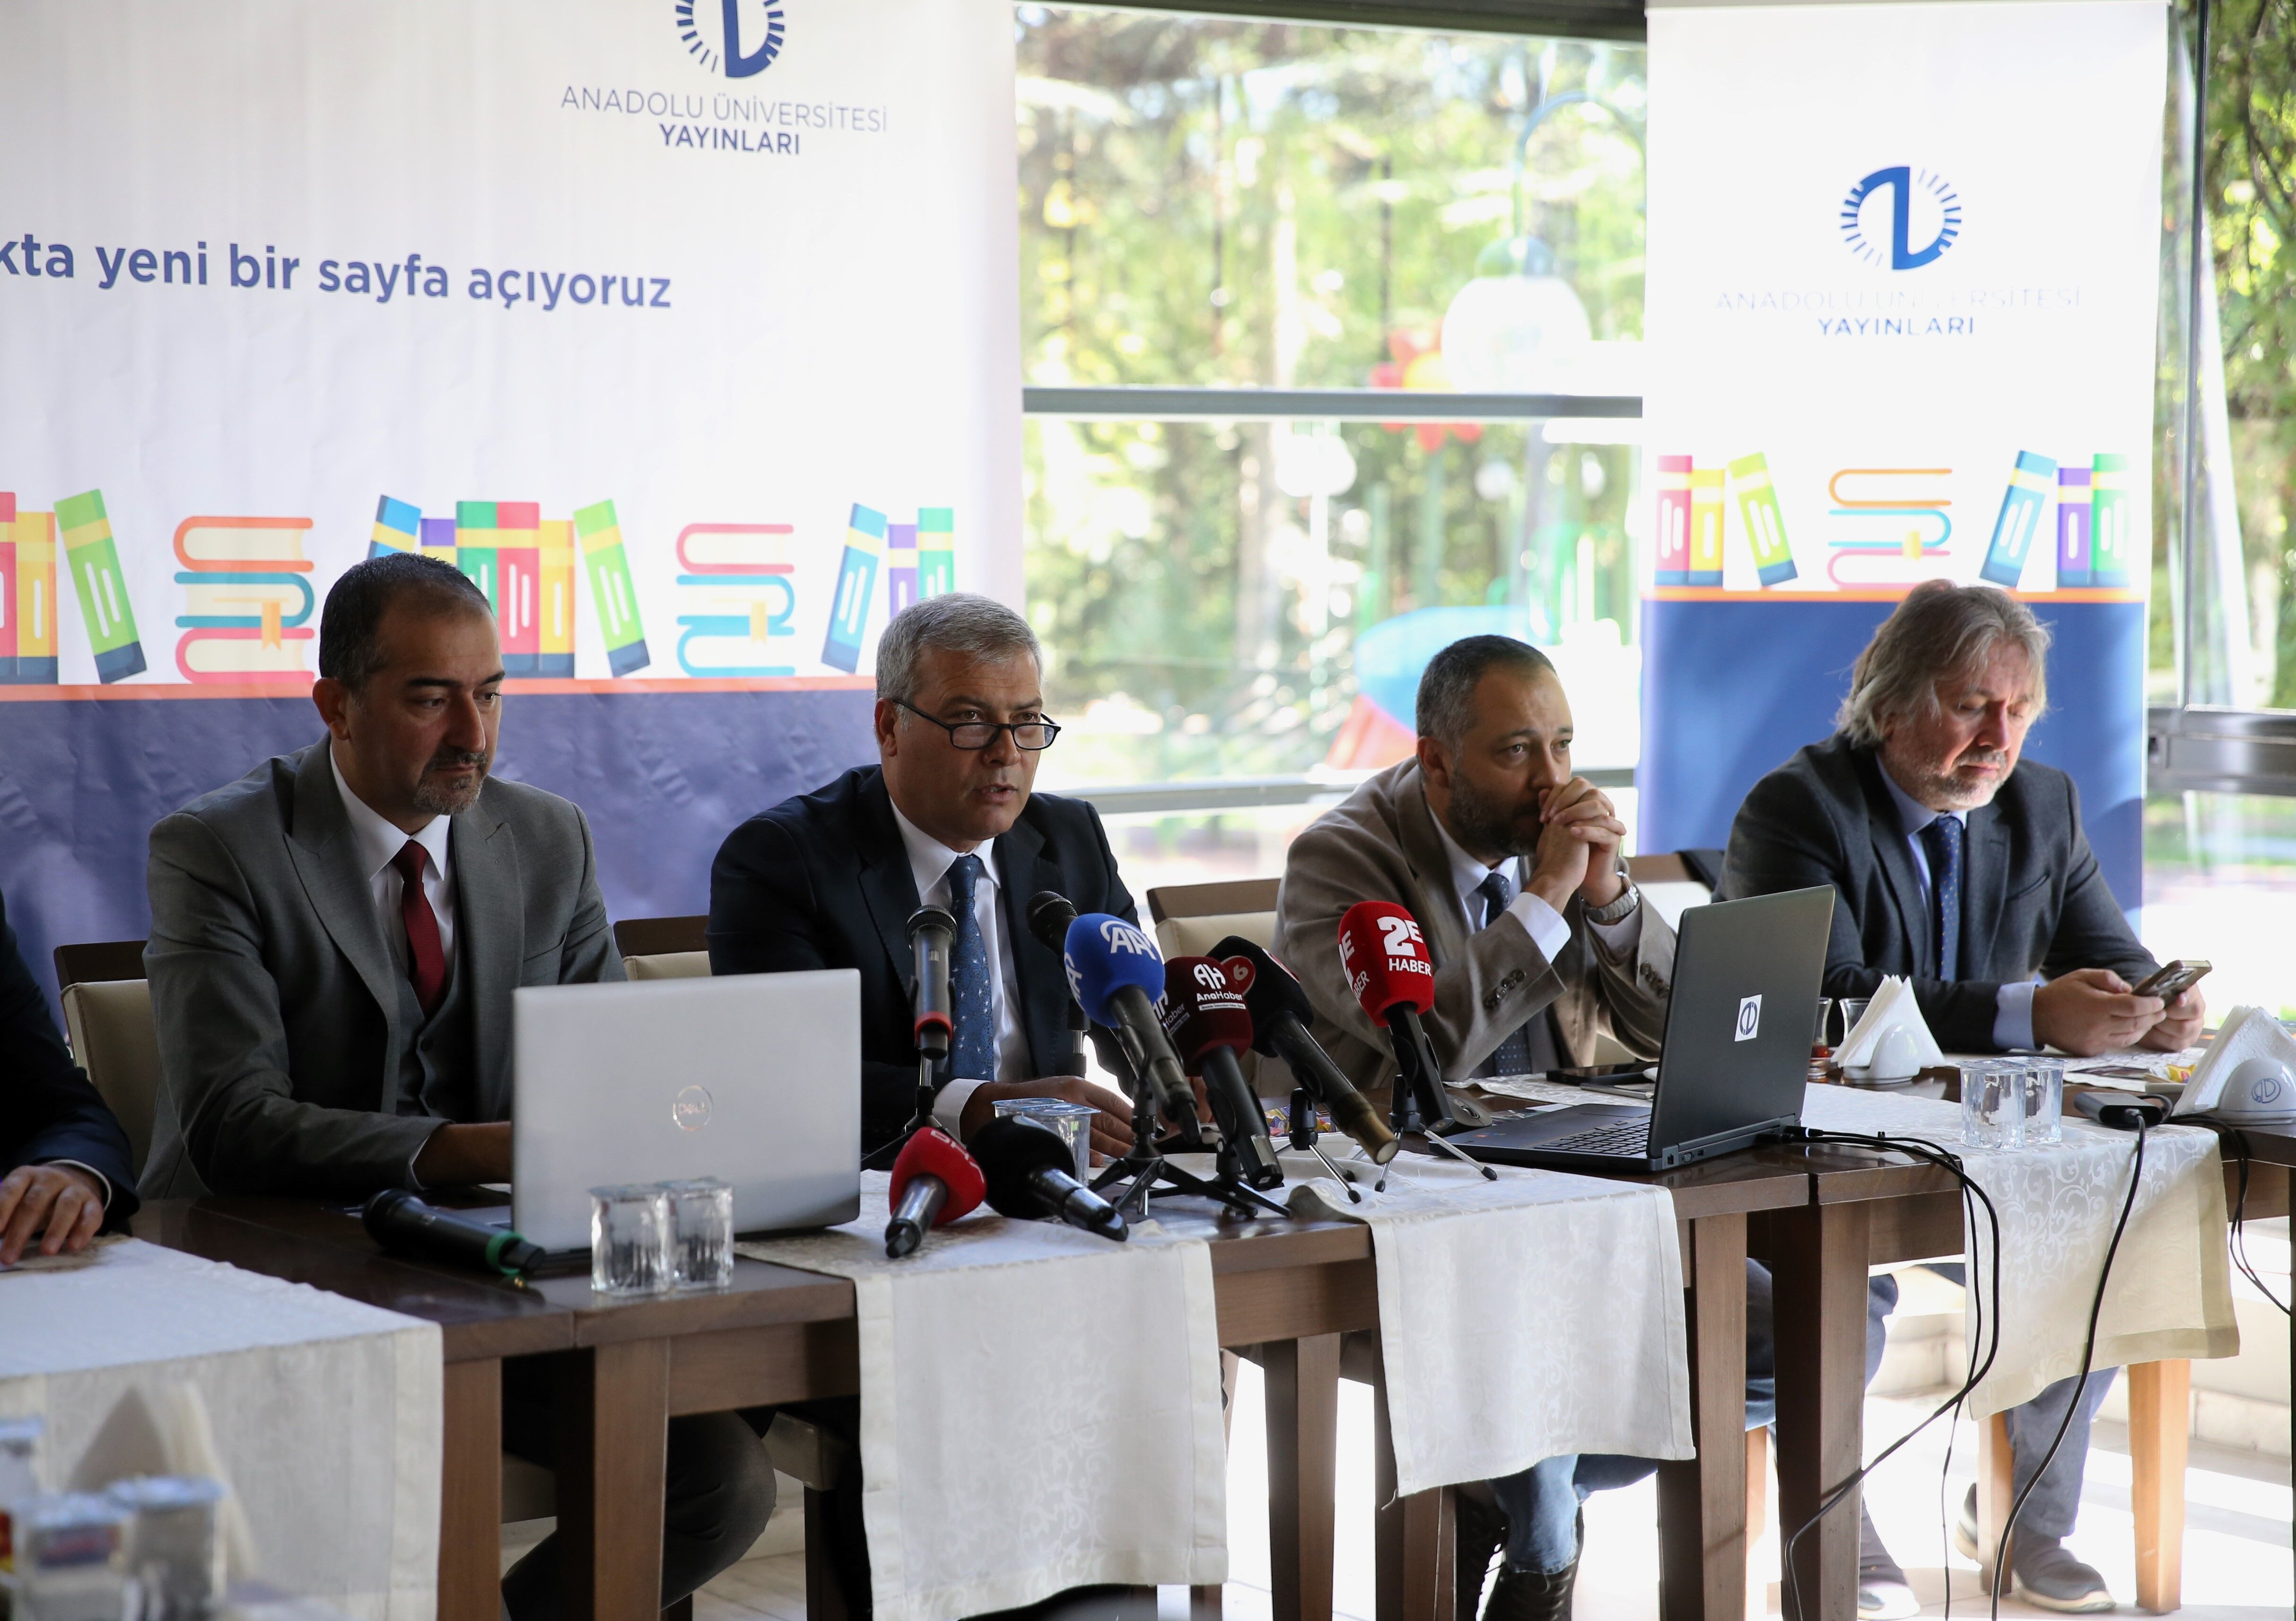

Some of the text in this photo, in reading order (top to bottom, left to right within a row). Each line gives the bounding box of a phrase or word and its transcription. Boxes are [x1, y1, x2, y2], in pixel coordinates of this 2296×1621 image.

[561, 85, 887, 133] ANADOLU ÜNİVERSİTESİ
[659, 123, 800, 155] YAYINLARI
[95, 241, 207, 290] yeni
[229, 243, 300, 289] bir
[318, 253, 448, 303] sayfa
[468, 268, 671, 311] açıyoruz
[1714, 291, 1864, 311] ANADOLU
[1817, 316, 1974, 336] YAYINLARI
[1388, 958, 1432, 977] HABER
[1196, 990, 1243, 1002] AnaHaber
